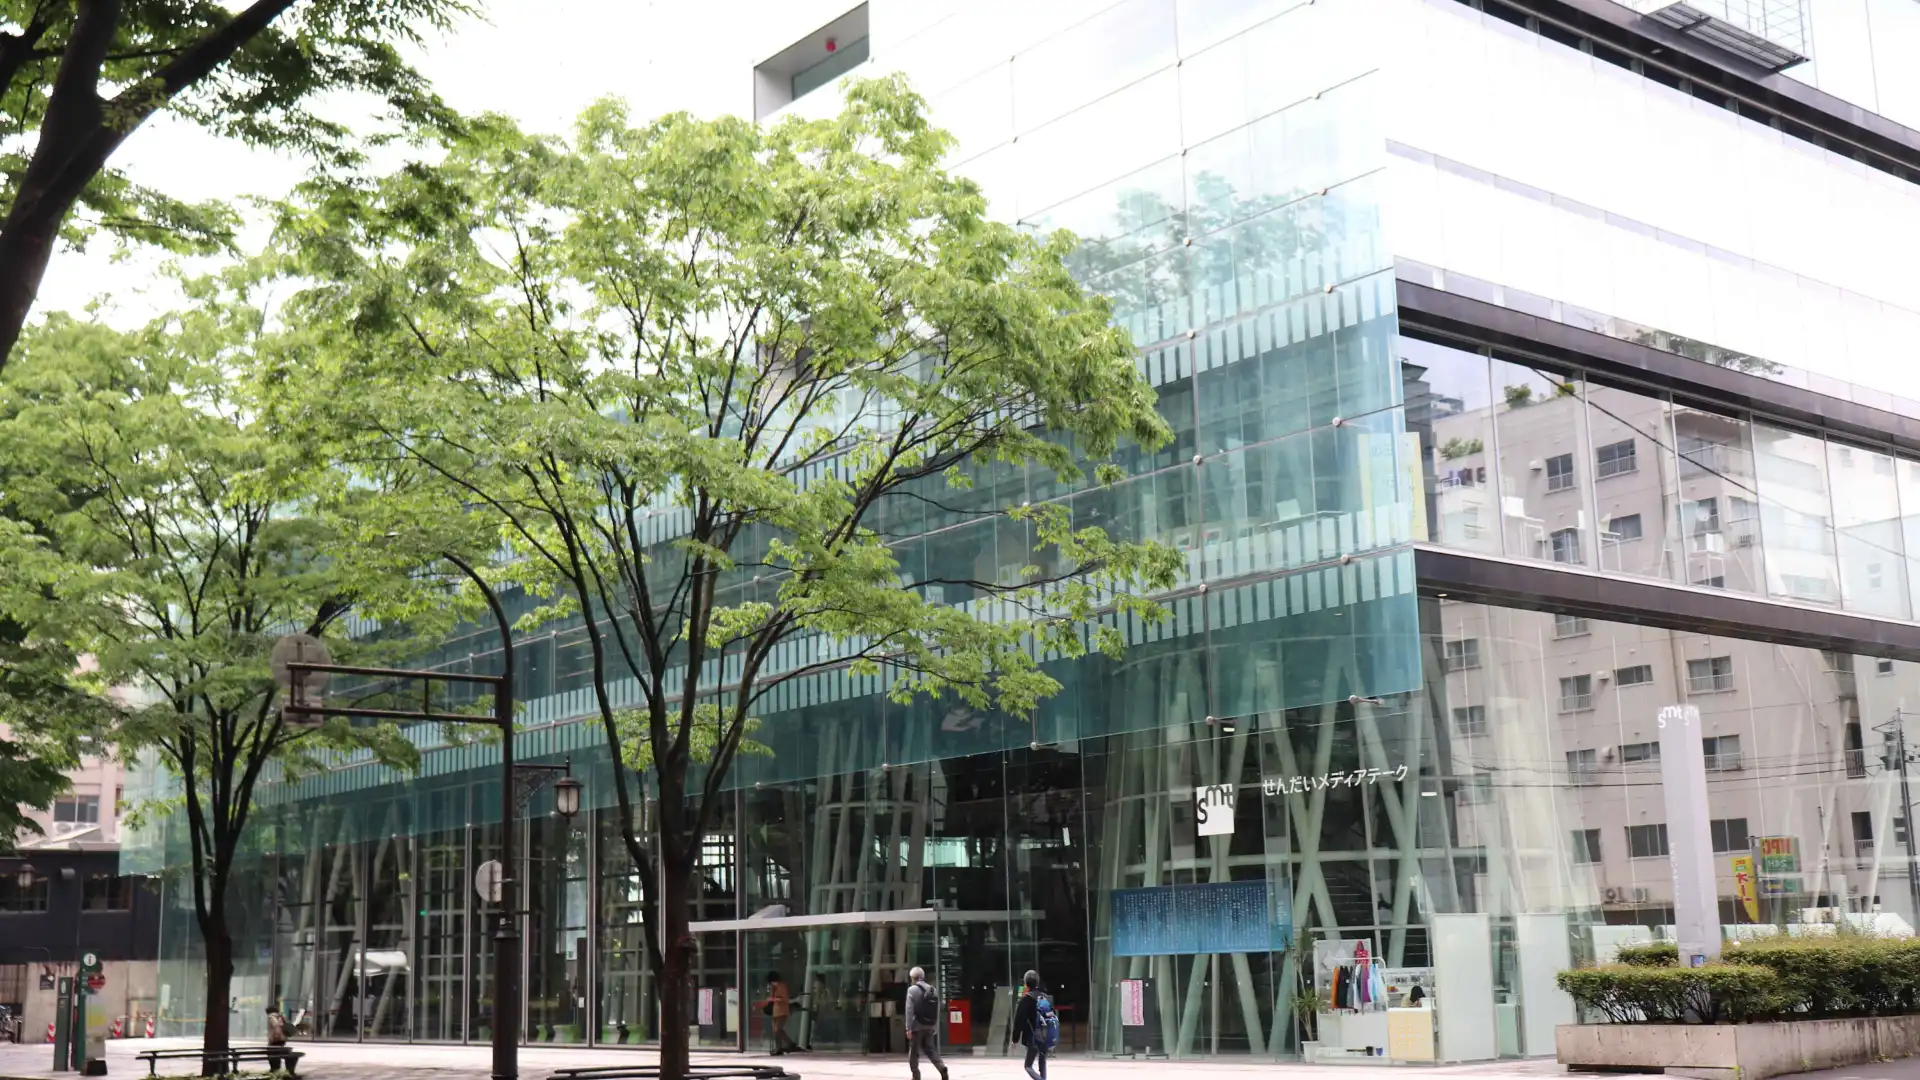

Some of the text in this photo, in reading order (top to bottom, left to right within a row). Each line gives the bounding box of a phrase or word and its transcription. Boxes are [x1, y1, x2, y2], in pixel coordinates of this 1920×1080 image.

[1262, 764, 1408, 796] せんだいメディアテーク
